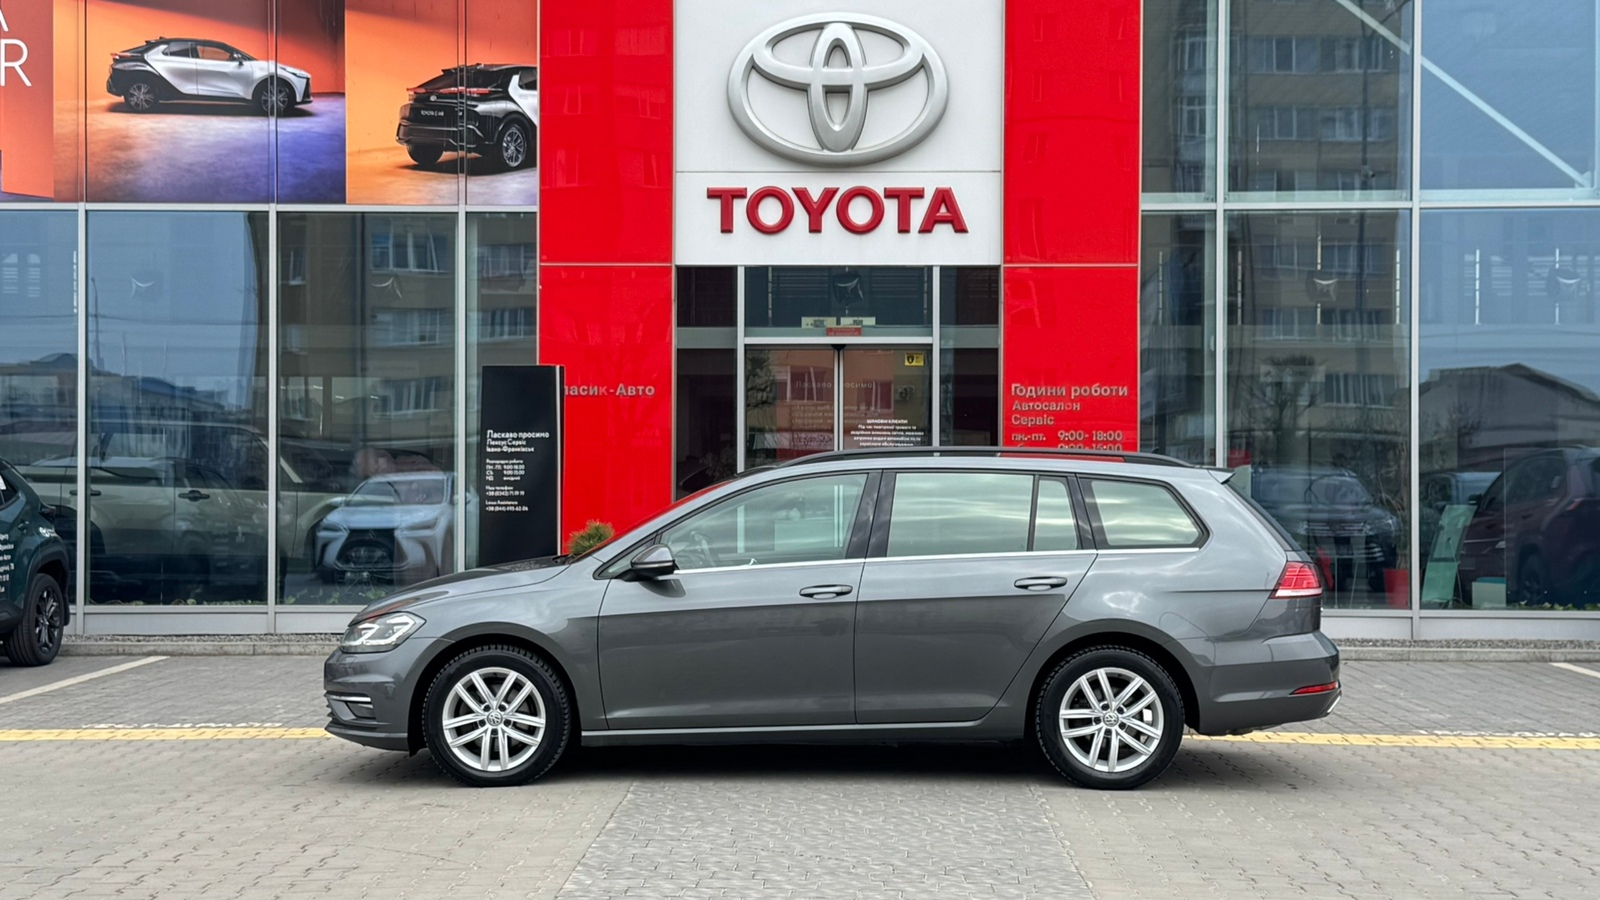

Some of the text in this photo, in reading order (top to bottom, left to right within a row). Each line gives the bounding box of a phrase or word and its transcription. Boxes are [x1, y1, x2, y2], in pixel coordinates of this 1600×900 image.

[706, 185, 969, 235] TOYOTA
[1011, 382, 1128, 399] Години роботи
[1012, 400, 1081, 411] Автосалон
[1011, 414, 1055, 427] Сервіс
[487, 430, 518, 438] Ласкаво
